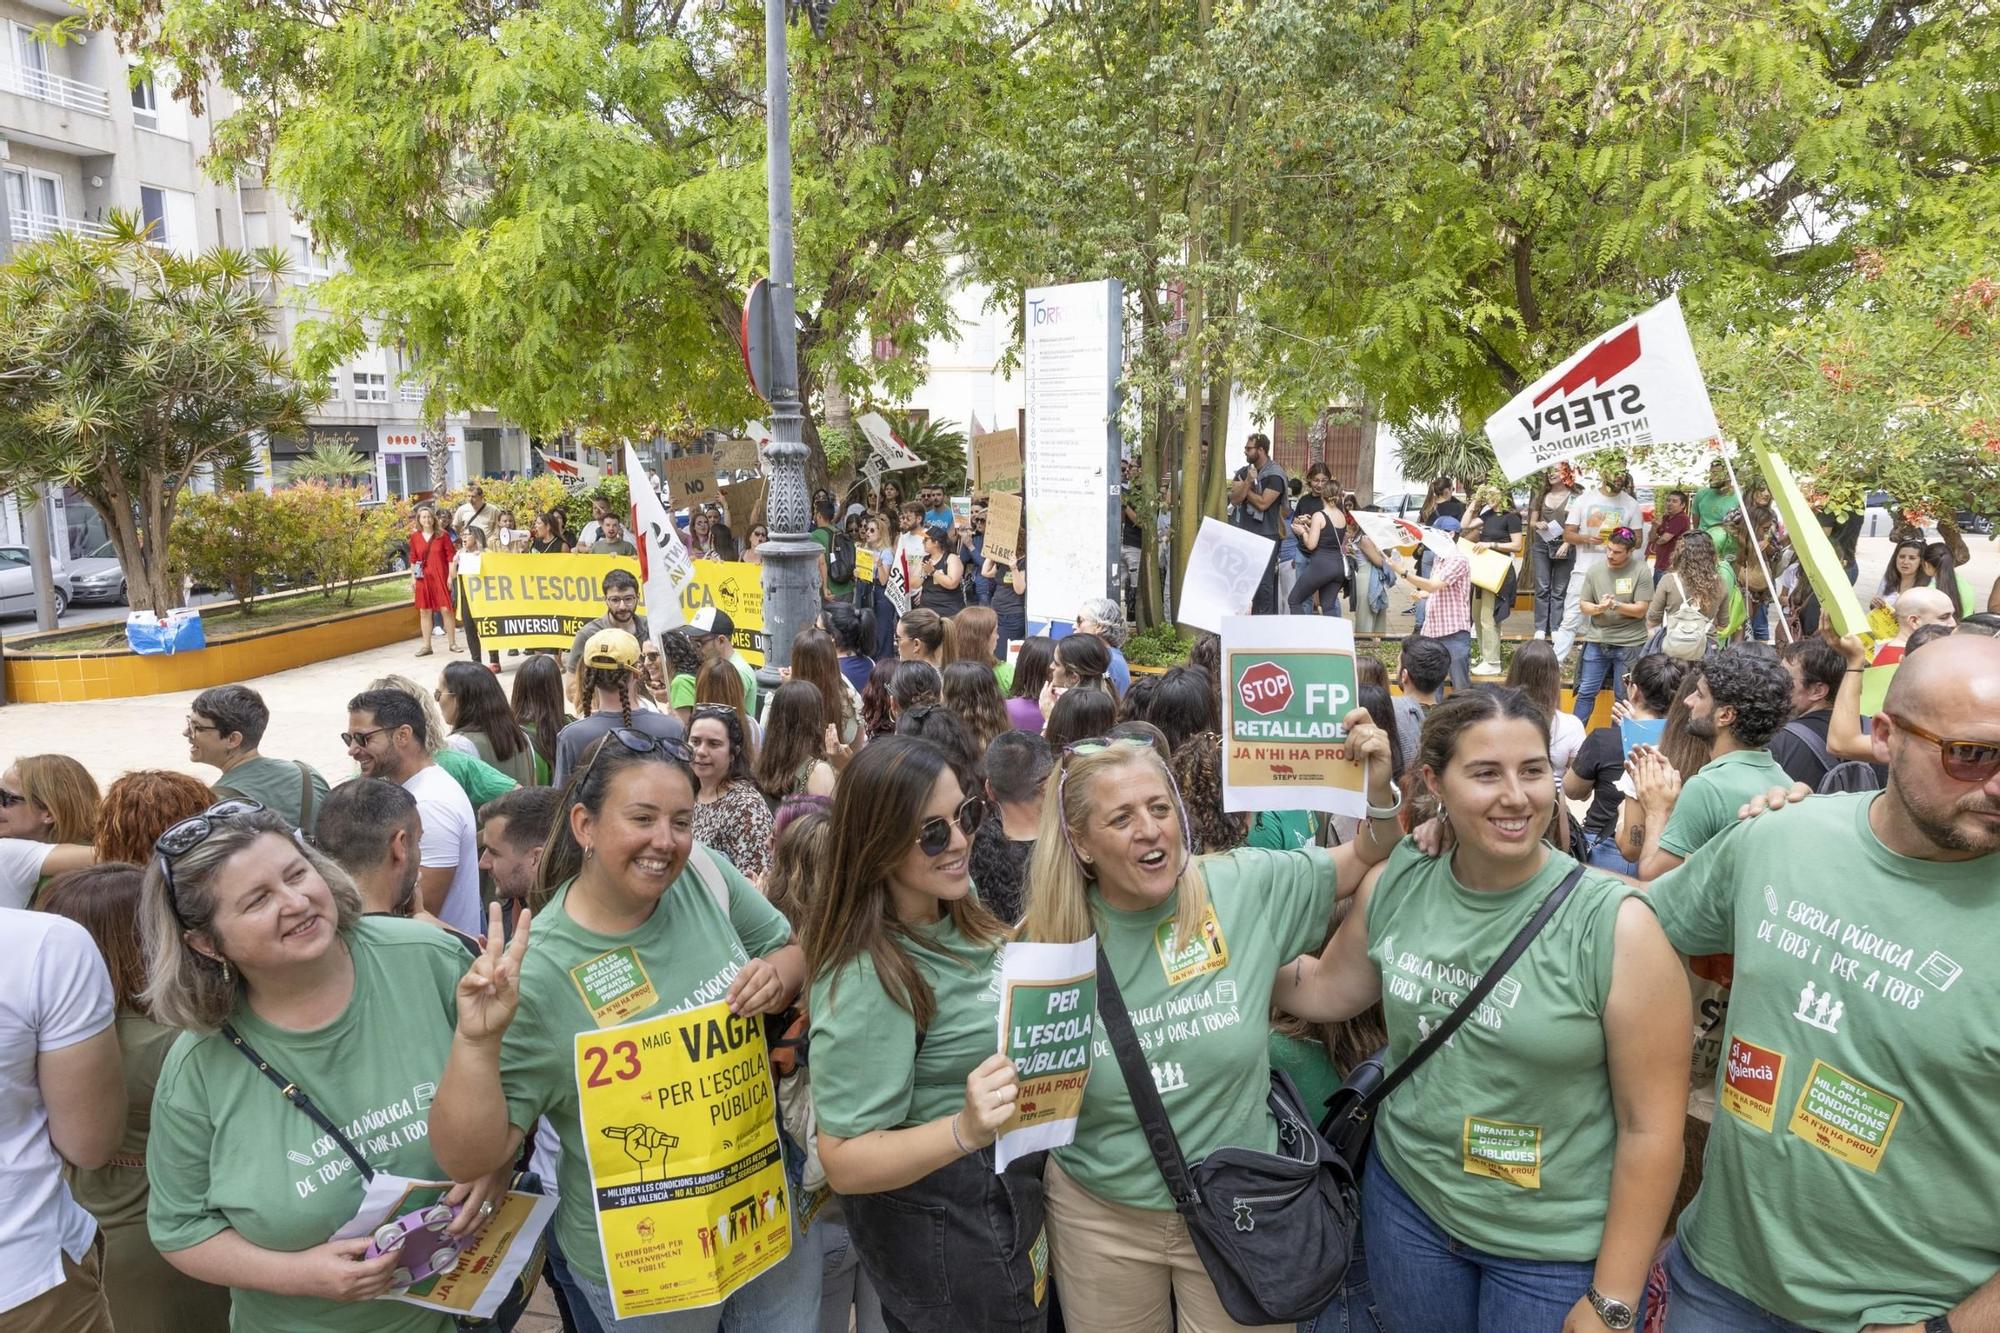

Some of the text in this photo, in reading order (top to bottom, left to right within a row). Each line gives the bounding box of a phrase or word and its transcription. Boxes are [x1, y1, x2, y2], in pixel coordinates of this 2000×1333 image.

[684, 480, 705, 495] NO
[468, 574, 603, 602] PER L'ESCOL
[504, 615, 559, 635] INVERSIÓ
[731, 629, 751, 648] MÉS
[1242, 674, 1350, 715] STOP FP
[1234, 720, 1348, 738] RETALLADE
[1233, 747, 1251, 760] JA
[1255, 747, 1284, 760] N'HI
[1289, 748, 1311, 760] HA
[1787, 900, 1914, 971] ESCOLA PÚBLICA
[583, 956, 629, 984] RETALLADES
[586, 963, 598, 974] NO
[604, 953, 618, 965] LES
[586, 963, 633, 992] D'UNITATS EN
[1756, 919, 1776, 943] DE
[1777, 927, 1811, 959] TOTS
[1829, 952, 1860, 982] PER
[1862, 970, 1881, 992] A
[1881, 975, 1924, 1010] TOTS
[1047, 988, 1080, 1015] PER
[1166, 989, 1214, 1018] PÚBLICA
[1389, 975, 1416, 1001] TOTS
[1431, 987, 1458, 1008] PER
[1013, 1013, 1092, 1049] L'ESCOLA
[1093, 1040, 1110, 1057] DE
[1167, 1022, 1200, 1043] PARA
[1201, 1005, 1240, 1033] TOD@S
[584, 1012, 760, 1089] 23 MAIG VAGA
[1015, 1045, 1087, 1076] PÚBLICA
[1740, 1051, 1751, 1064] al
[658, 1053, 765, 1110] PER L'ESCOLA
[1728, 1060, 1773, 1083] Valencià
[1036, 1082, 1052, 1095] HA
[1814, 1076, 1890, 1120] MILLORA DE LES
[1840, 1080, 1868, 1098] PER LA
[361, 1098, 414, 1134] PÚBLICA
[710, 1084, 769, 1126] PÚBLICA
[1749, 1101, 1771, 1117] PROU!
[1810, 1087, 1886, 1131] CONDICIONS
[1473, 1124, 1517, 1136] INFANTIL
[1798, 1112, 1878, 1158] JA N'HI HA PROU!
[1808, 1101, 1877, 1141] LABORALS
[1471, 1146, 1536, 1162] PÚBLIQUES
[1479, 1136, 1520, 1147] DIGNES
[295, 1175, 318, 1199] DE
[315, 1157, 353, 1185] TOD@
[367, 1131, 403, 1154] PARA
[401, 1119, 428, 1143] TOD
[1511, 1167, 1536, 1176] PROU!
[607, 1185, 641, 1197] MILLOREM
[642, 1183, 654, 1195] LES
[655, 1177, 693, 1192] CONDICIONS
[694, 1171, 725, 1185] LABORALS
[628, 1196, 637, 1205] AL
[674, 1189, 685, 1198] NO
[685, 1188, 694, 1196] AL
[695, 1181, 725, 1195] DISTRICTE
[437, 1284, 454, 1301] JA
